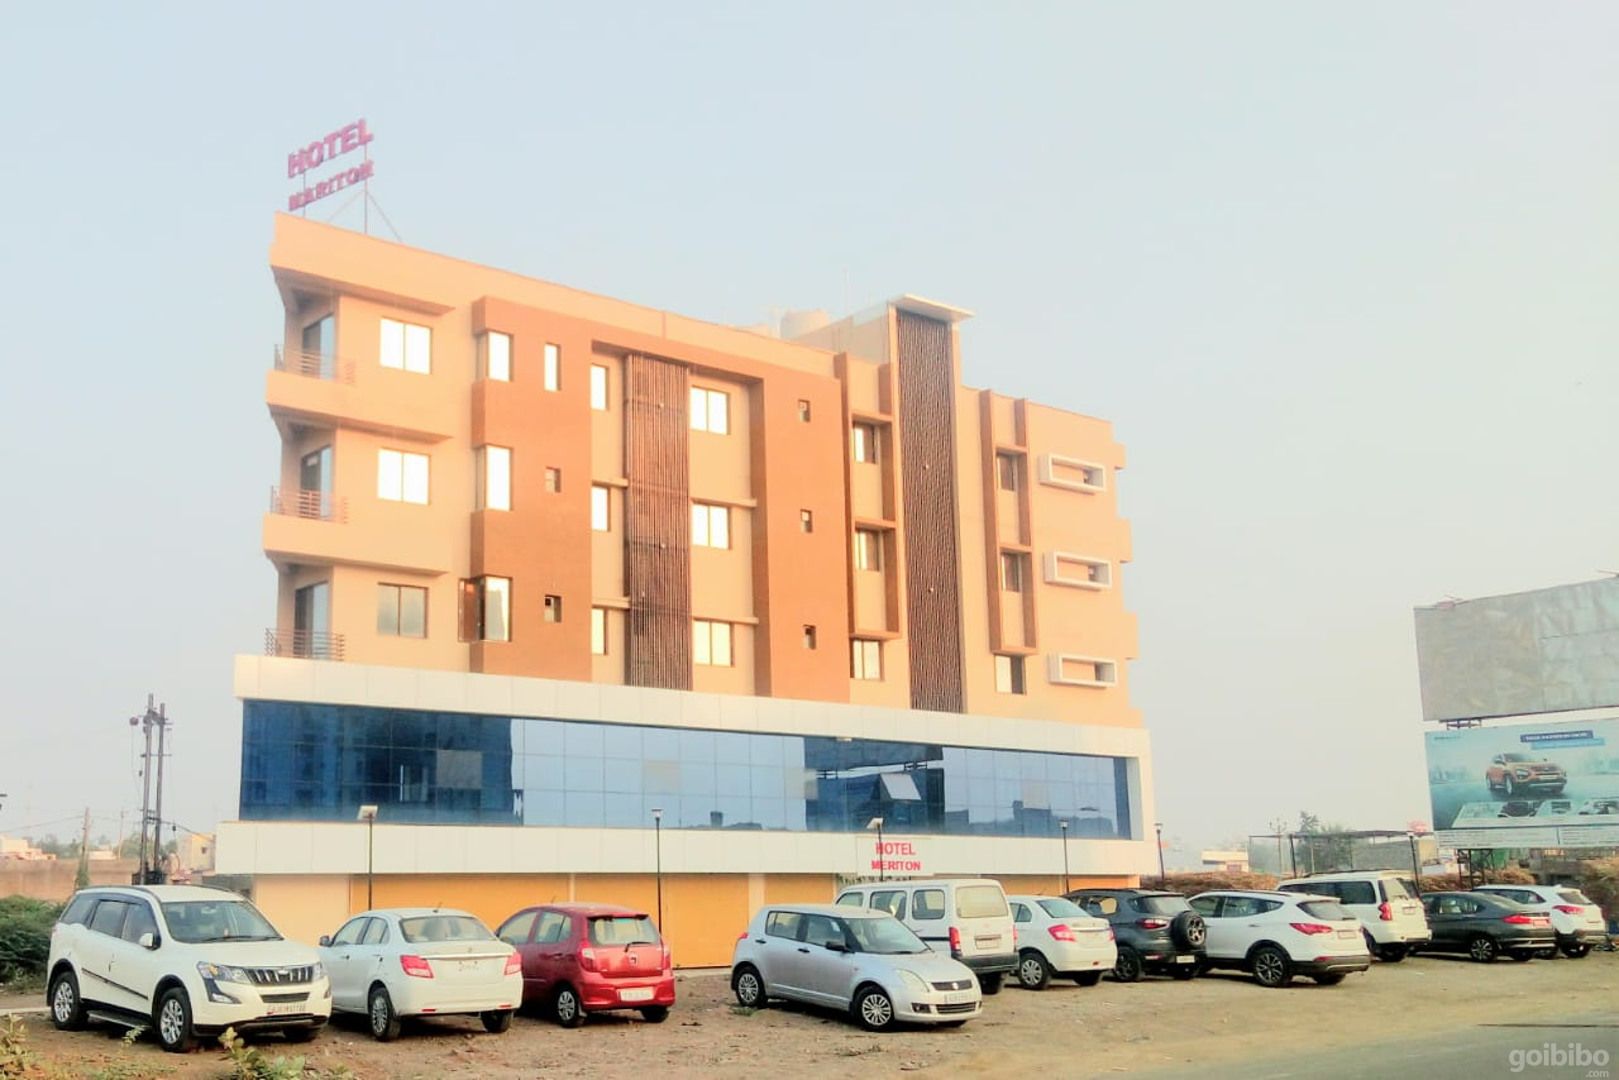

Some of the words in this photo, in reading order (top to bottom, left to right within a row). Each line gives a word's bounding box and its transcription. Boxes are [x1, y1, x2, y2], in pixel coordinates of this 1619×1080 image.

[288, 118, 374, 178] HOTEL
[875, 842, 916, 856] HOTEL
[871, 860, 921, 871] MERITON
